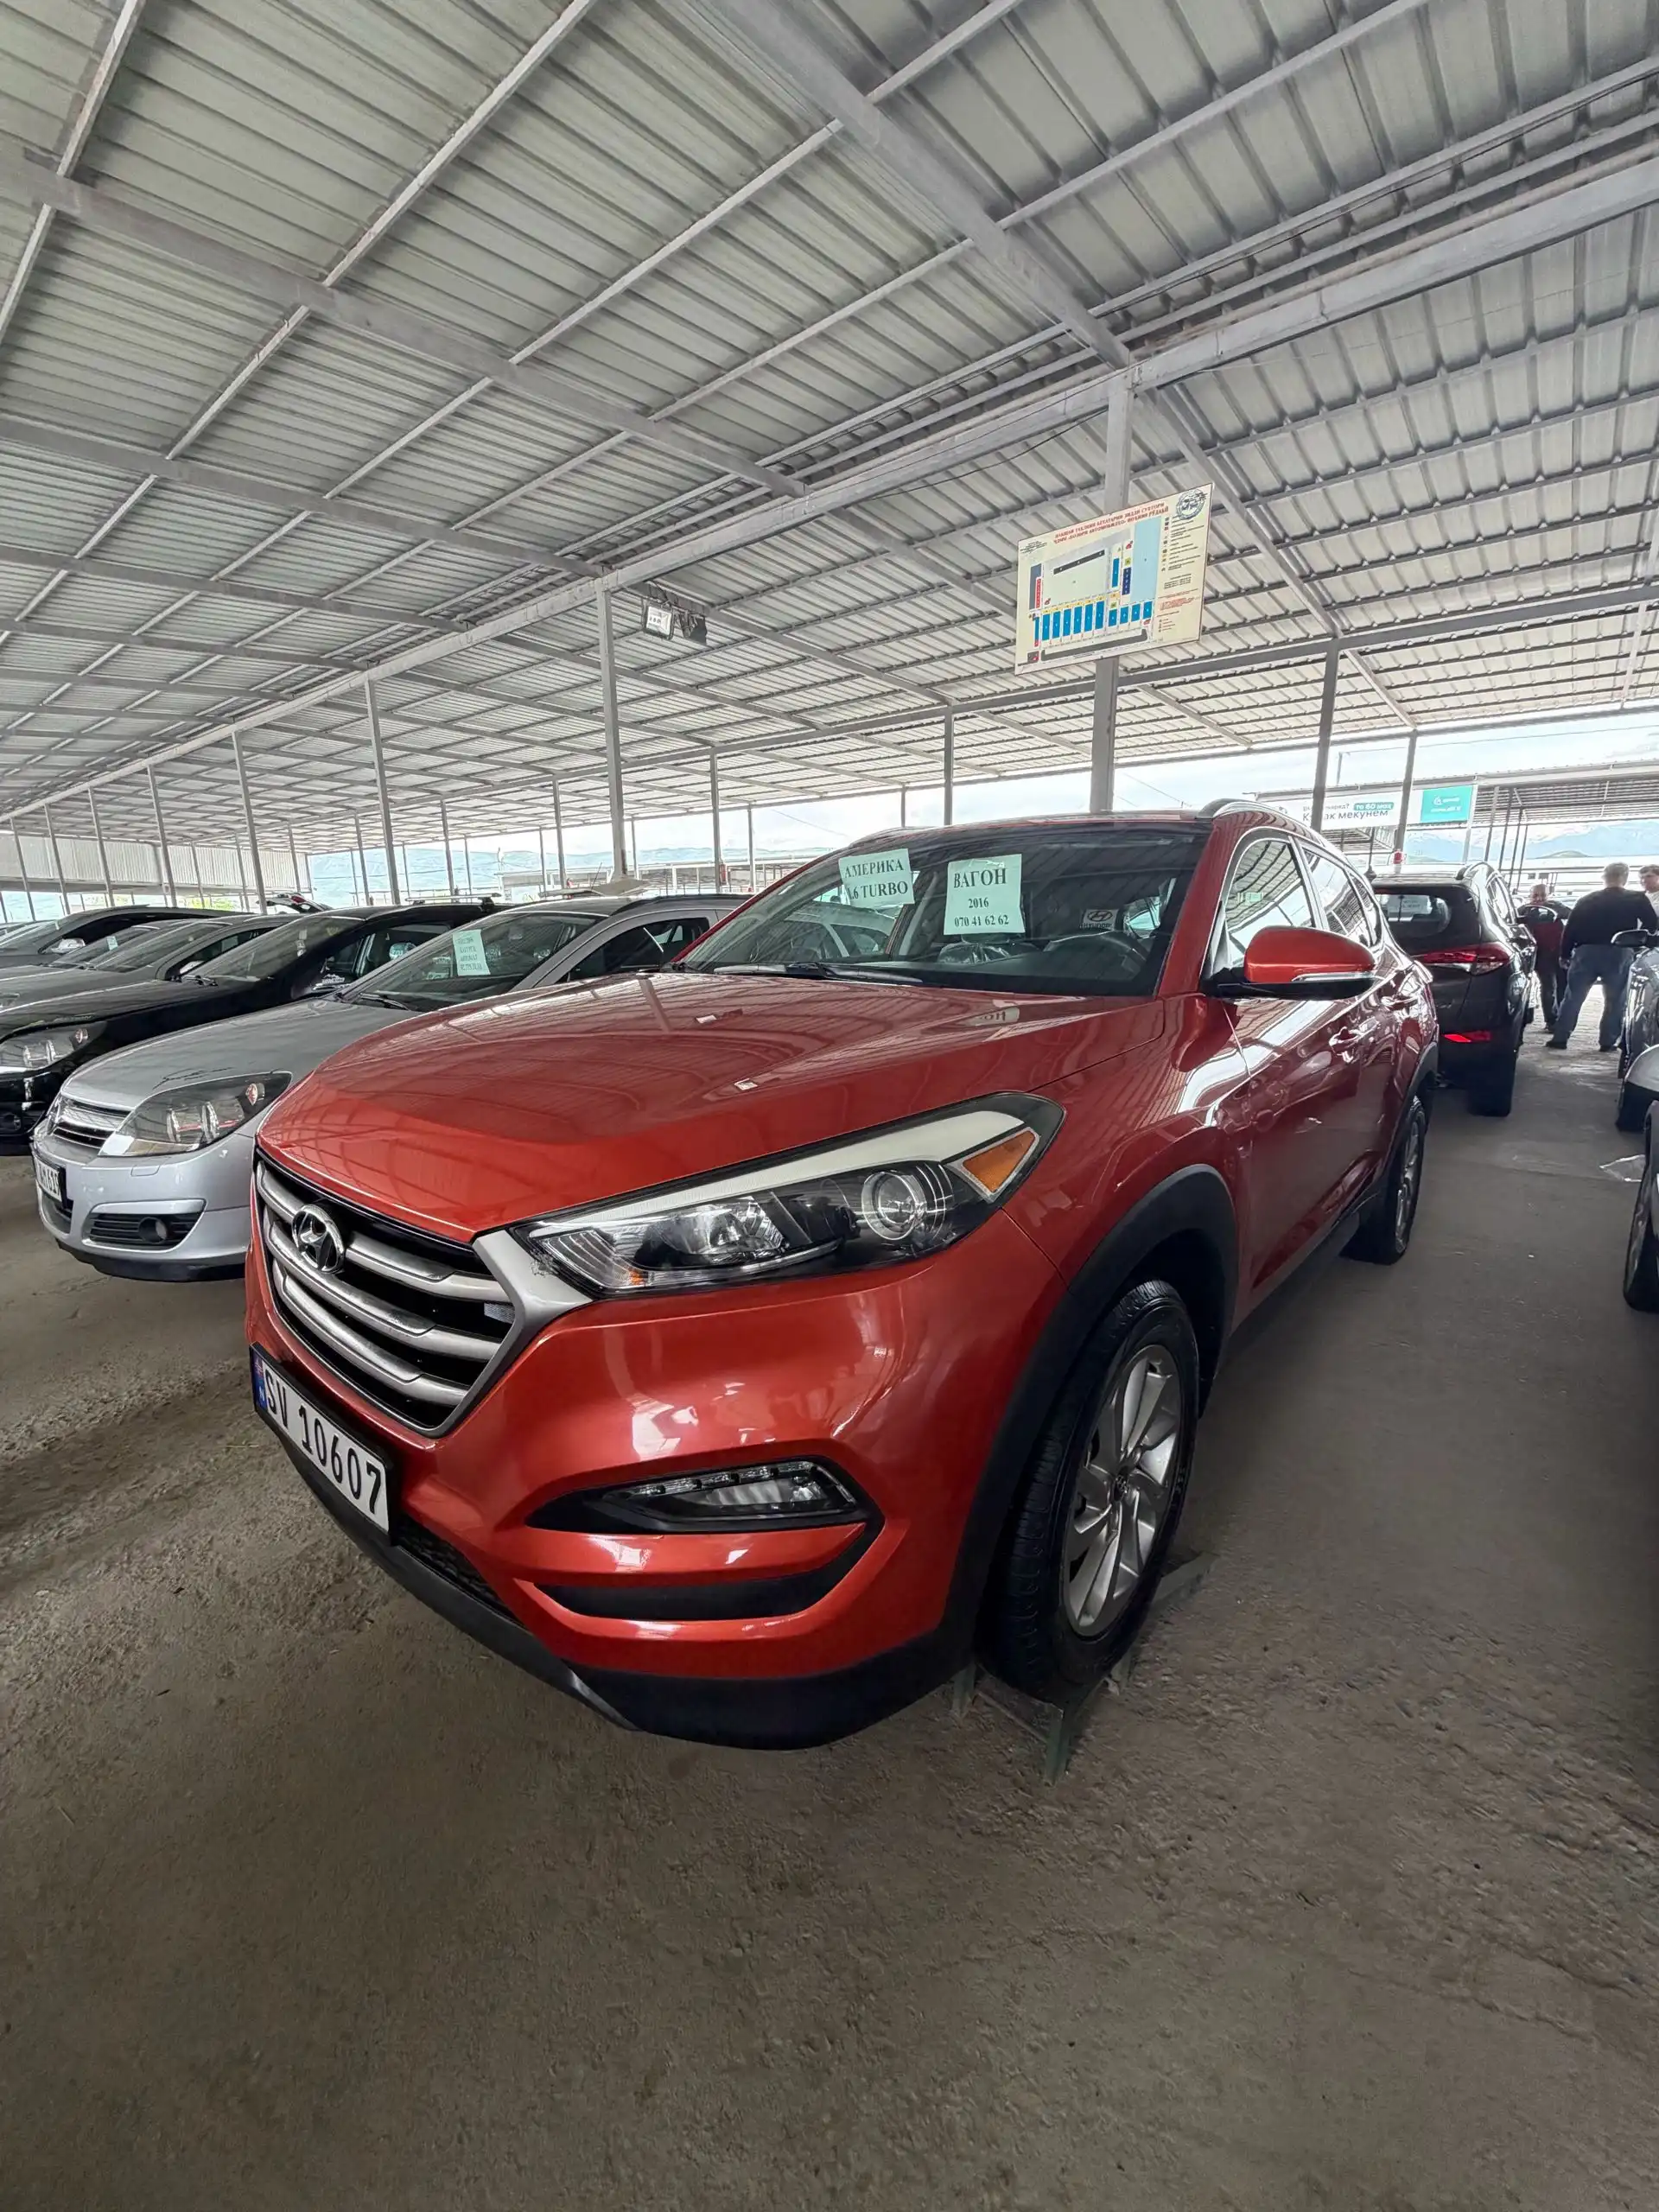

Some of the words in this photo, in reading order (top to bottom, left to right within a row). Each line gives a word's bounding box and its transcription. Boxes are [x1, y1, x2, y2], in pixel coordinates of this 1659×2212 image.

[845, 859, 905, 878] АМЕРИКА
[953, 868, 1007, 888] ВАГОН
[848, 886, 859, 899] 1.6
[861, 880, 908, 898] TURBO
[968, 897, 989, 908] 2016
[954, 916, 969, 927] 070
[971, 916, 982, 926] 41
[985, 915, 995, 925] 62
[997, 914, 1009, 925] 62
[265, 1369, 288, 1428] SV
[299, 1404, 381, 1515] 10607
